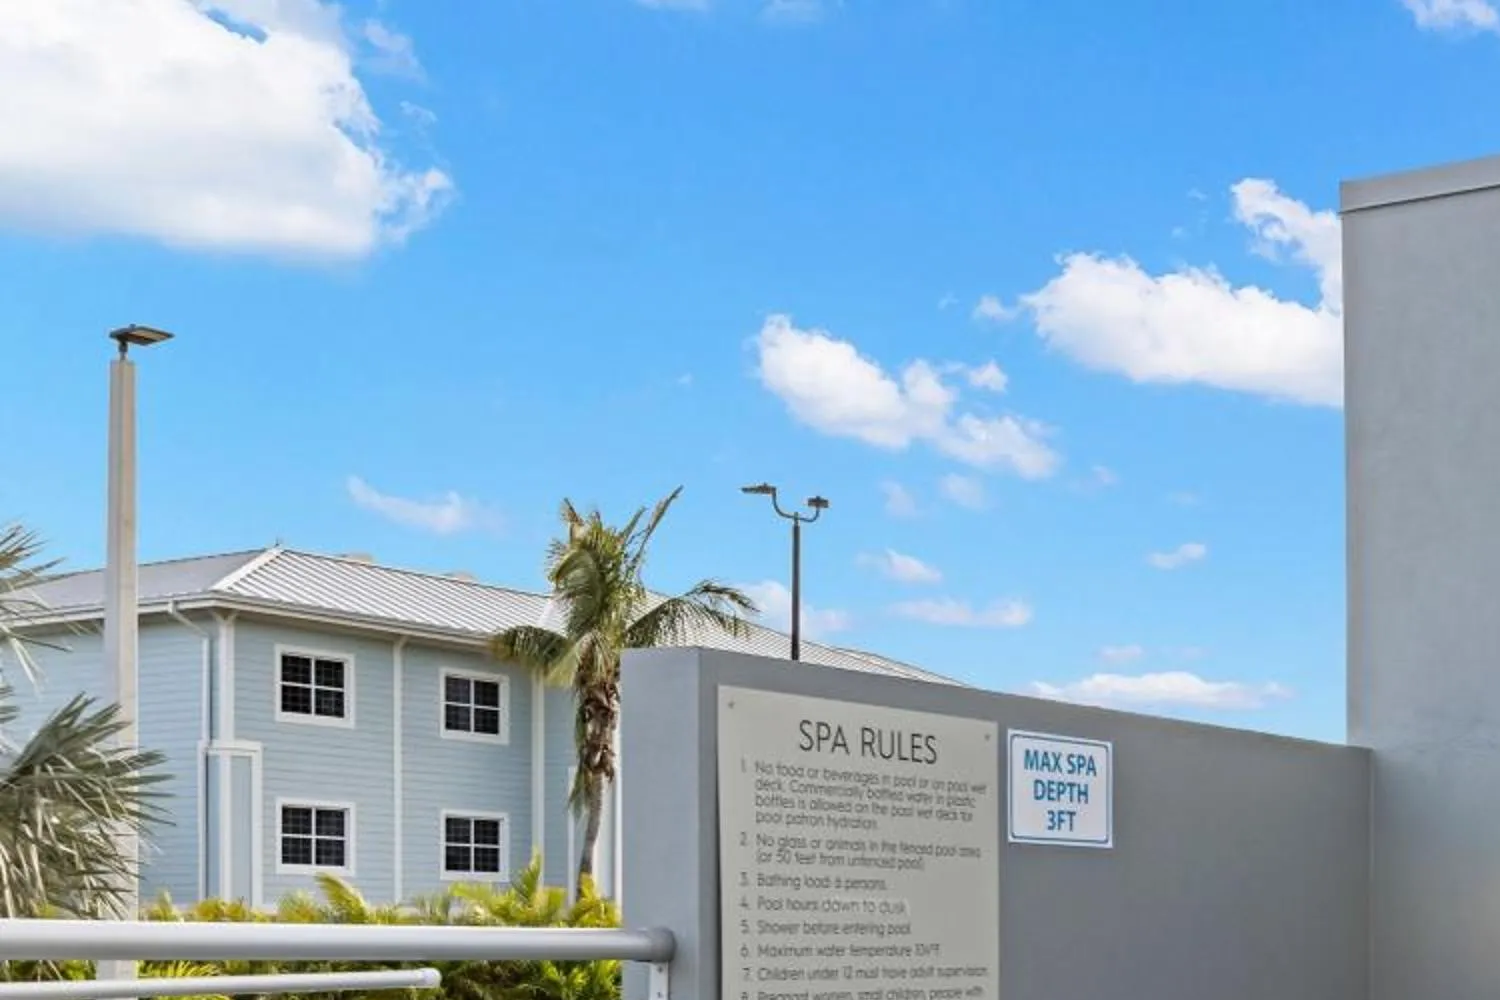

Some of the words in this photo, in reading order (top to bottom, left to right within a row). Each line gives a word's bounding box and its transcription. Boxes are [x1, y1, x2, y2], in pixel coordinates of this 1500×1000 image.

[799, 719, 850, 756] SPA
[861, 727, 937, 765] RULES
[1024, 748, 1062, 773] MAX
[1066, 753, 1097, 776] SPA
[755, 761, 773, 775] No
[775, 762, 805, 778] food
[807, 767, 819, 779] or
[823, 768, 880, 788] beverages
[882, 774, 891, 785] in
[893, 775, 916, 791] pool
[919, 779, 929, 789] or
[931, 780, 945, 791] on
[947, 780, 968, 794] pool
[970, 783, 987, 795] wet
[790, 779, 865, 801] Commercially
[867, 786, 904, 802] bottled
[907, 792, 933, 804] water
[936, 794, 945, 805] in
[947, 795, 976, 809] plastic
[1034, 779, 1088, 804] DEPTH
[755, 793, 795, 809] bottles
[798, 799, 806, 809] is
[810, 798, 852, 813] allowed
[855, 802, 868, 813] on
[871, 801, 888, 815] the
[891, 804, 913, 818] pool
[917, 807, 933, 819] wet
[936, 808, 959, 821] deck
[960, 809, 973, 822] for
[755, 811, 783, 825] pool
[785, 813, 825, 829] patron
[1047, 809, 1076, 832] 3FT
[756, 832, 775, 847] No
[777, 834, 807, 851] glass
[810, 838, 821, 849] or
[826, 838, 866, 852] animals
[869, 839, 879, 852] in
[881, 840, 897, 853] the
[899, 841, 933, 856] fenced
[935, 844, 957, 859] pool
[776, 848, 792, 864] 50
[794, 850, 816, 865] feet
[819, 851, 844, 866] from
[847, 853, 896, 869] unfenced
[757, 873, 801, 890] Bathing
[757, 895, 783, 911] Pool
[862, 899, 876, 913] to
[757, 919, 800, 935] Shower
[803, 919, 840, 935] before
[842, 920, 884, 938] entering
[757, 943, 814, 958] Maximum
[816, 943, 846, 957] water
[849, 943, 912, 959] temperature
[757, 966, 805, 982] Children
[807, 966, 839, 981] under
[842, 965, 853, 980] 12
[855, 965, 880, 980] must
[882, 965, 907, 980] have
[910, 964, 935, 979] adult
[965, 984, 984, 997] with
